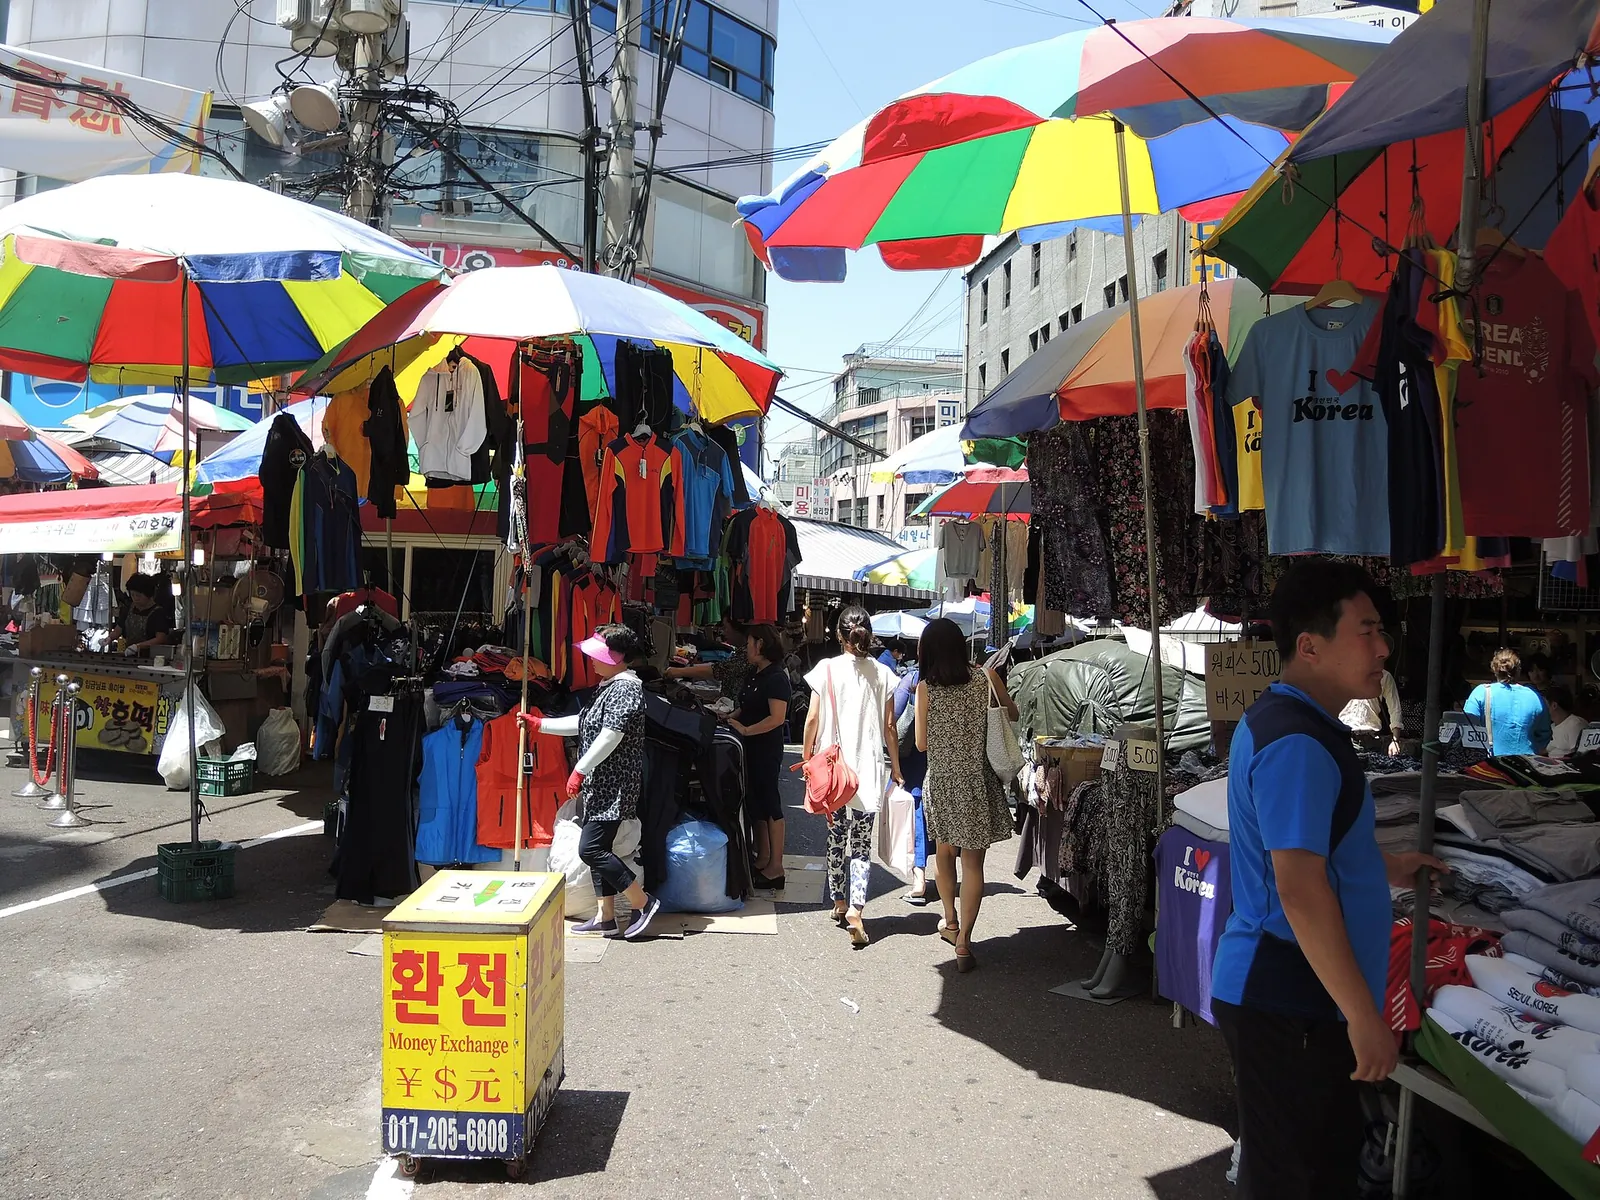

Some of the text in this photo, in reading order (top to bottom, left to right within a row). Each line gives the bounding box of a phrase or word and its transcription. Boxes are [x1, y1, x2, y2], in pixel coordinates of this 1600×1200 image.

[1308, 369, 1318, 392] I
[1247, 410, 1256, 430] I
[1293, 396, 1374, 423] Korea
[795, 485, 810, 515] 미용
[1212, 651, 1247, 677] 원피스
[1215, 688, 1246, 712] 바지
[1184, 846, 1193, 866] I
[1175, 866, 1214, 899] Korea
[391, 949, 507, 1027] 환전
[389, 1032, 509, 1059] Money Exchange
[396, 1065, 501, 1104] ¥ $ 元
[388, 1114, 508, 1154] 017-205-6808
